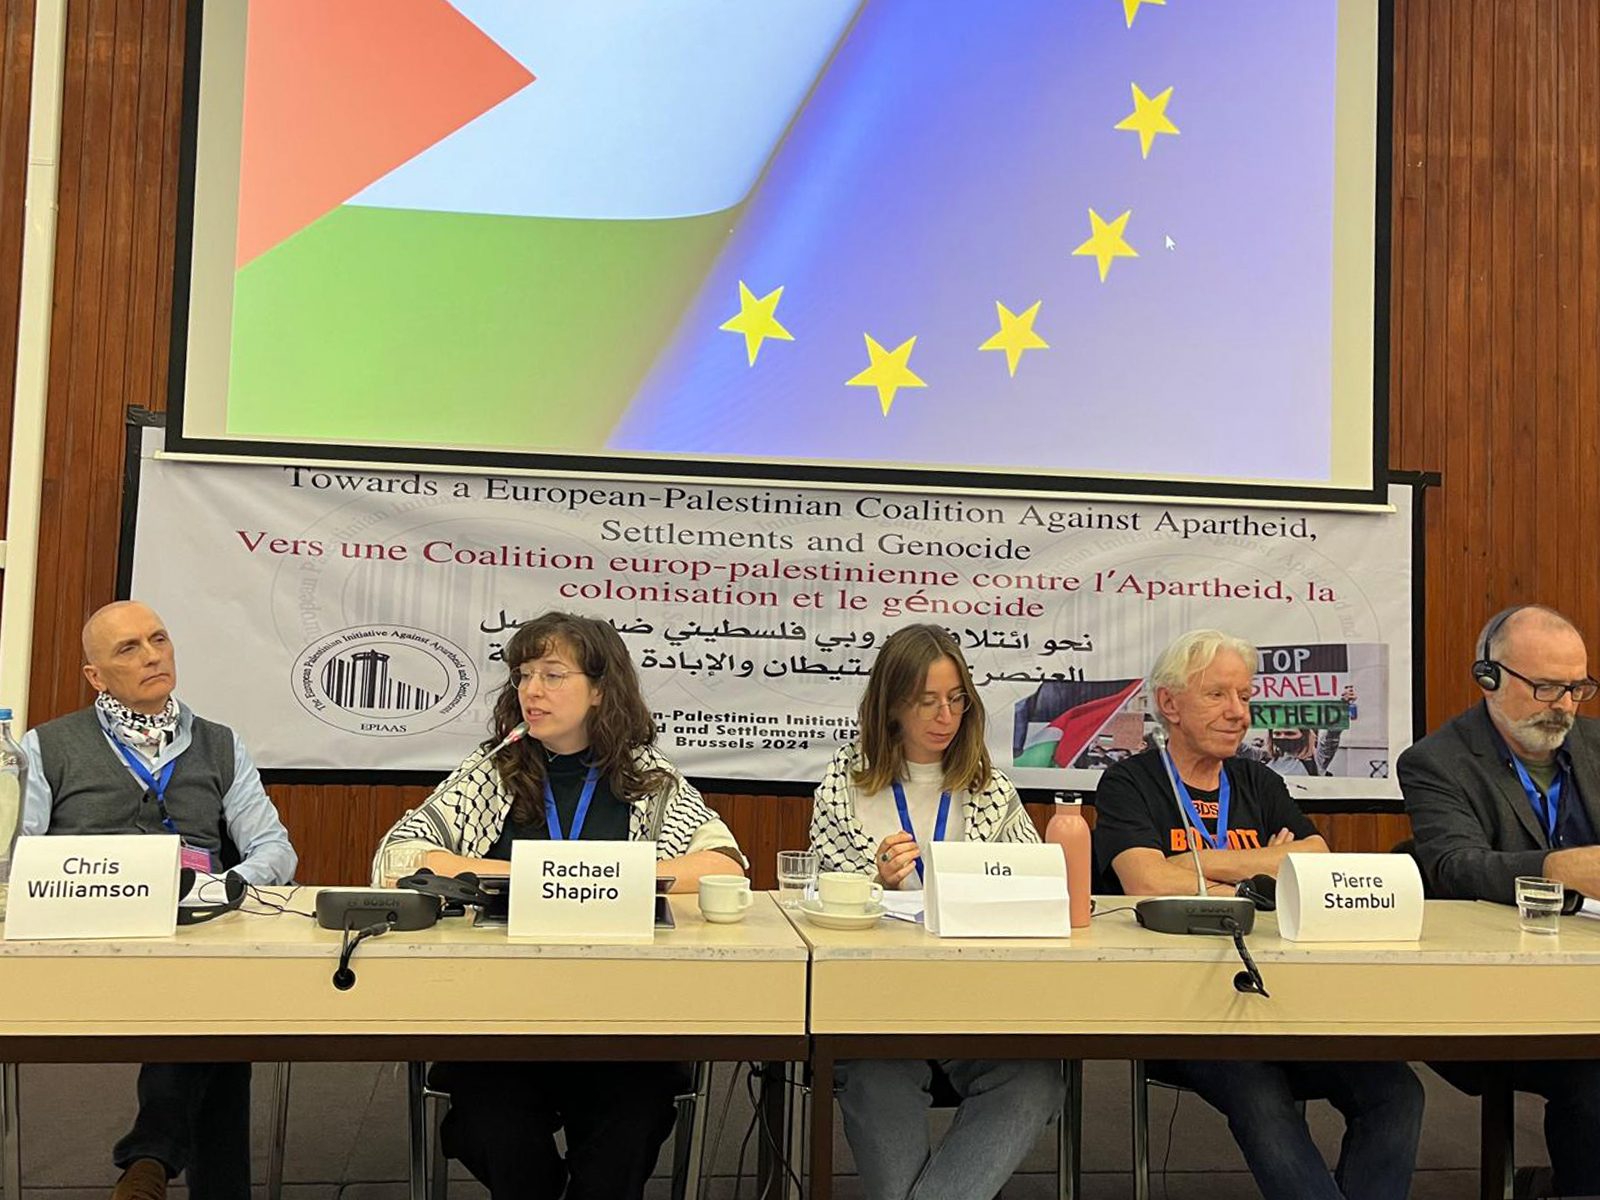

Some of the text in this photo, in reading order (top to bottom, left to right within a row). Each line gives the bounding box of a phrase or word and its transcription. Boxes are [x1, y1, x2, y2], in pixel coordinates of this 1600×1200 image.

[283, 465, 437, 497] Towards
[453, 480, 470, 498] a
[484, 477, 842, 517] European-Palestinian
[856, 496, 1005, 524] Coalition
[1018, 504, 1141, 533] Against
[1155, 510, 1317, 543] Apartheid,
[601, 519, 794, 551] Settlements
[807, 531, 865, 554] and
[877, 533, 1031, 561] Genocide
[237, 530, 324, 557] Vers
[341, 543, 408, 561] une
[423, 540, 596, 571] Coalition
[609, 555, 960, 589] europ-palestinienne
[972, 571, 1081, 592] contre
[1307, 581, 1337, 602] la
[559, 579, 1045, 618] colonisation et le génocide
[663, 619, 806, 645] فلسطيني
[1038, 633, 1094, 656] نحو
[310, 697, 326, 712] The
[342, 629, 388, 642] Initiative
[391, 630, 430, 645] Against
[641, 649, 754, 678] والإبادة
[1257, 648, 1311, 673] TOP
[1251, 674, 1338, 698] SRAELI
[361, 723, 407, 733] EPIAAS
[673, 723, 709, 735] and
[716, 724, 826, 739] Settlements
[787, 714, 859, 727] Initiativ
[676, 736, 809, 750] Brussels 2024
[62, 856, 120, 875] Chris
[542, 860, 621, 878] Rachael
[984, 861, 1012, 876] Ida
[28, 880, 150, 898] Williamson
[1331, 872, 1383, 889] Pierre
[541, 882, 619, 904] Shapiro
[1324, 891, 1396, 909] Stambul
